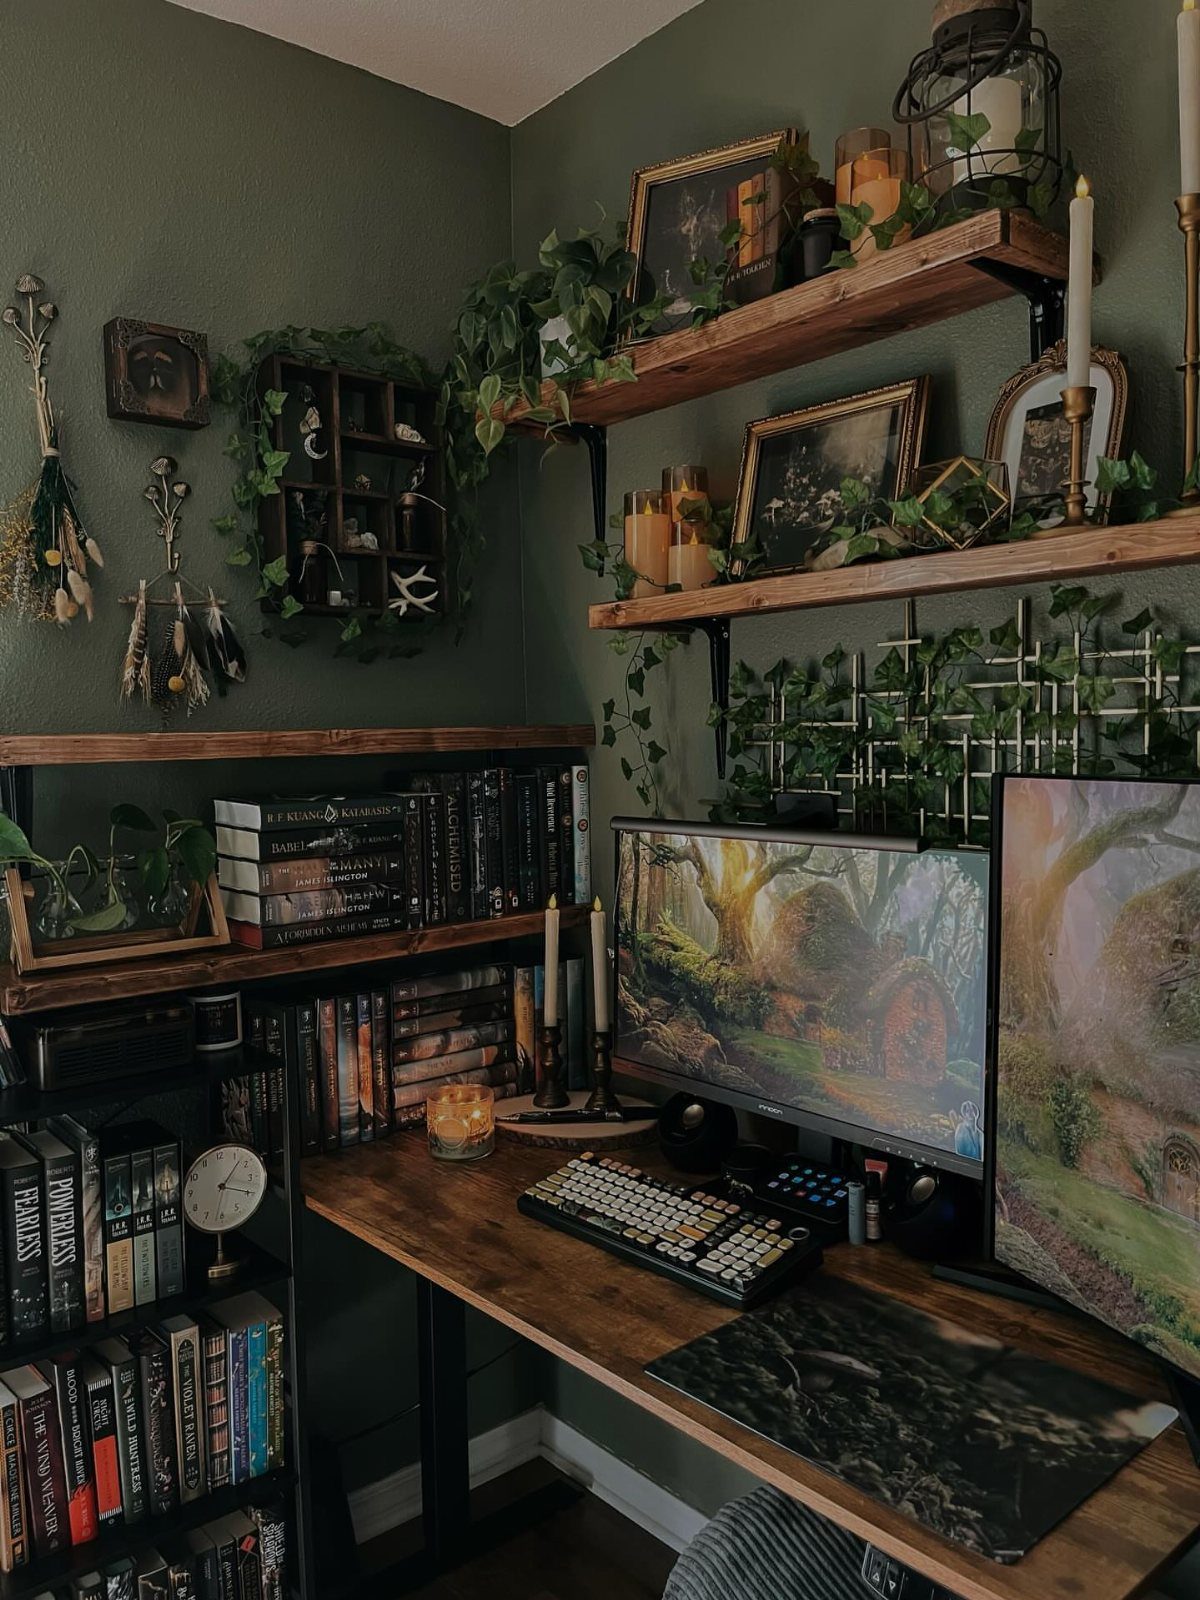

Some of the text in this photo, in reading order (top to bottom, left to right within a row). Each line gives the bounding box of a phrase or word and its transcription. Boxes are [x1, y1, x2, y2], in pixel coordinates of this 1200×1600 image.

[547, 781, 556, 797] Wild
[286, 811, 323, 822] KUANG
[342, 806, 391, 819] KATABASIS
[547, 799, 557, 833] Reverence
[271, 841, 307, 854] BABEL
[447, 793, 463, 894] ALCHEMISED
[295, 872, 368, 888] JAMES ISLINGTON
[340, 857, 382, 871] MANY
[298, 903, 371, 920] JAMES ISLINGTON
[202, 1159, 207, 1168] 11
[216, 1151, 223, 1160] 12
[190, 1173, 198, 1181] 10
[14, 1186, 42, 1262] FEARLESS
[49, 1176, 77, 1267] POWERLESS
[66, 1369, 78, 1403] BLOOD
[182, 1377, 194, 1420] VIOLET
[32, 1410, 47, 1439] THE
[92, 1400, 103, 1432] CIRCUS
[100, 1398, 110, 1426] NIGHT
[125, 1402, 136, 1432] WILD
[5, 1416, 16, 1446] CIRCE
[72, 1425, 83, 1457] BRIGHT
[184, 1422, 197, 1462] RAVEN
[36, 1440, 51, 1477] WIND
[75, 1459, 86, 1485] HAVEN
[128, 1434, 143, 1494] HUNTRESS
[8, 1453, 22, 1536] MADELINE MILLER
[41, 1476, 59, 1537] WEAVER
[263, 1523, 277, 1573] SPARROWS
[274, 1521, 286, 1556] SHIELD
